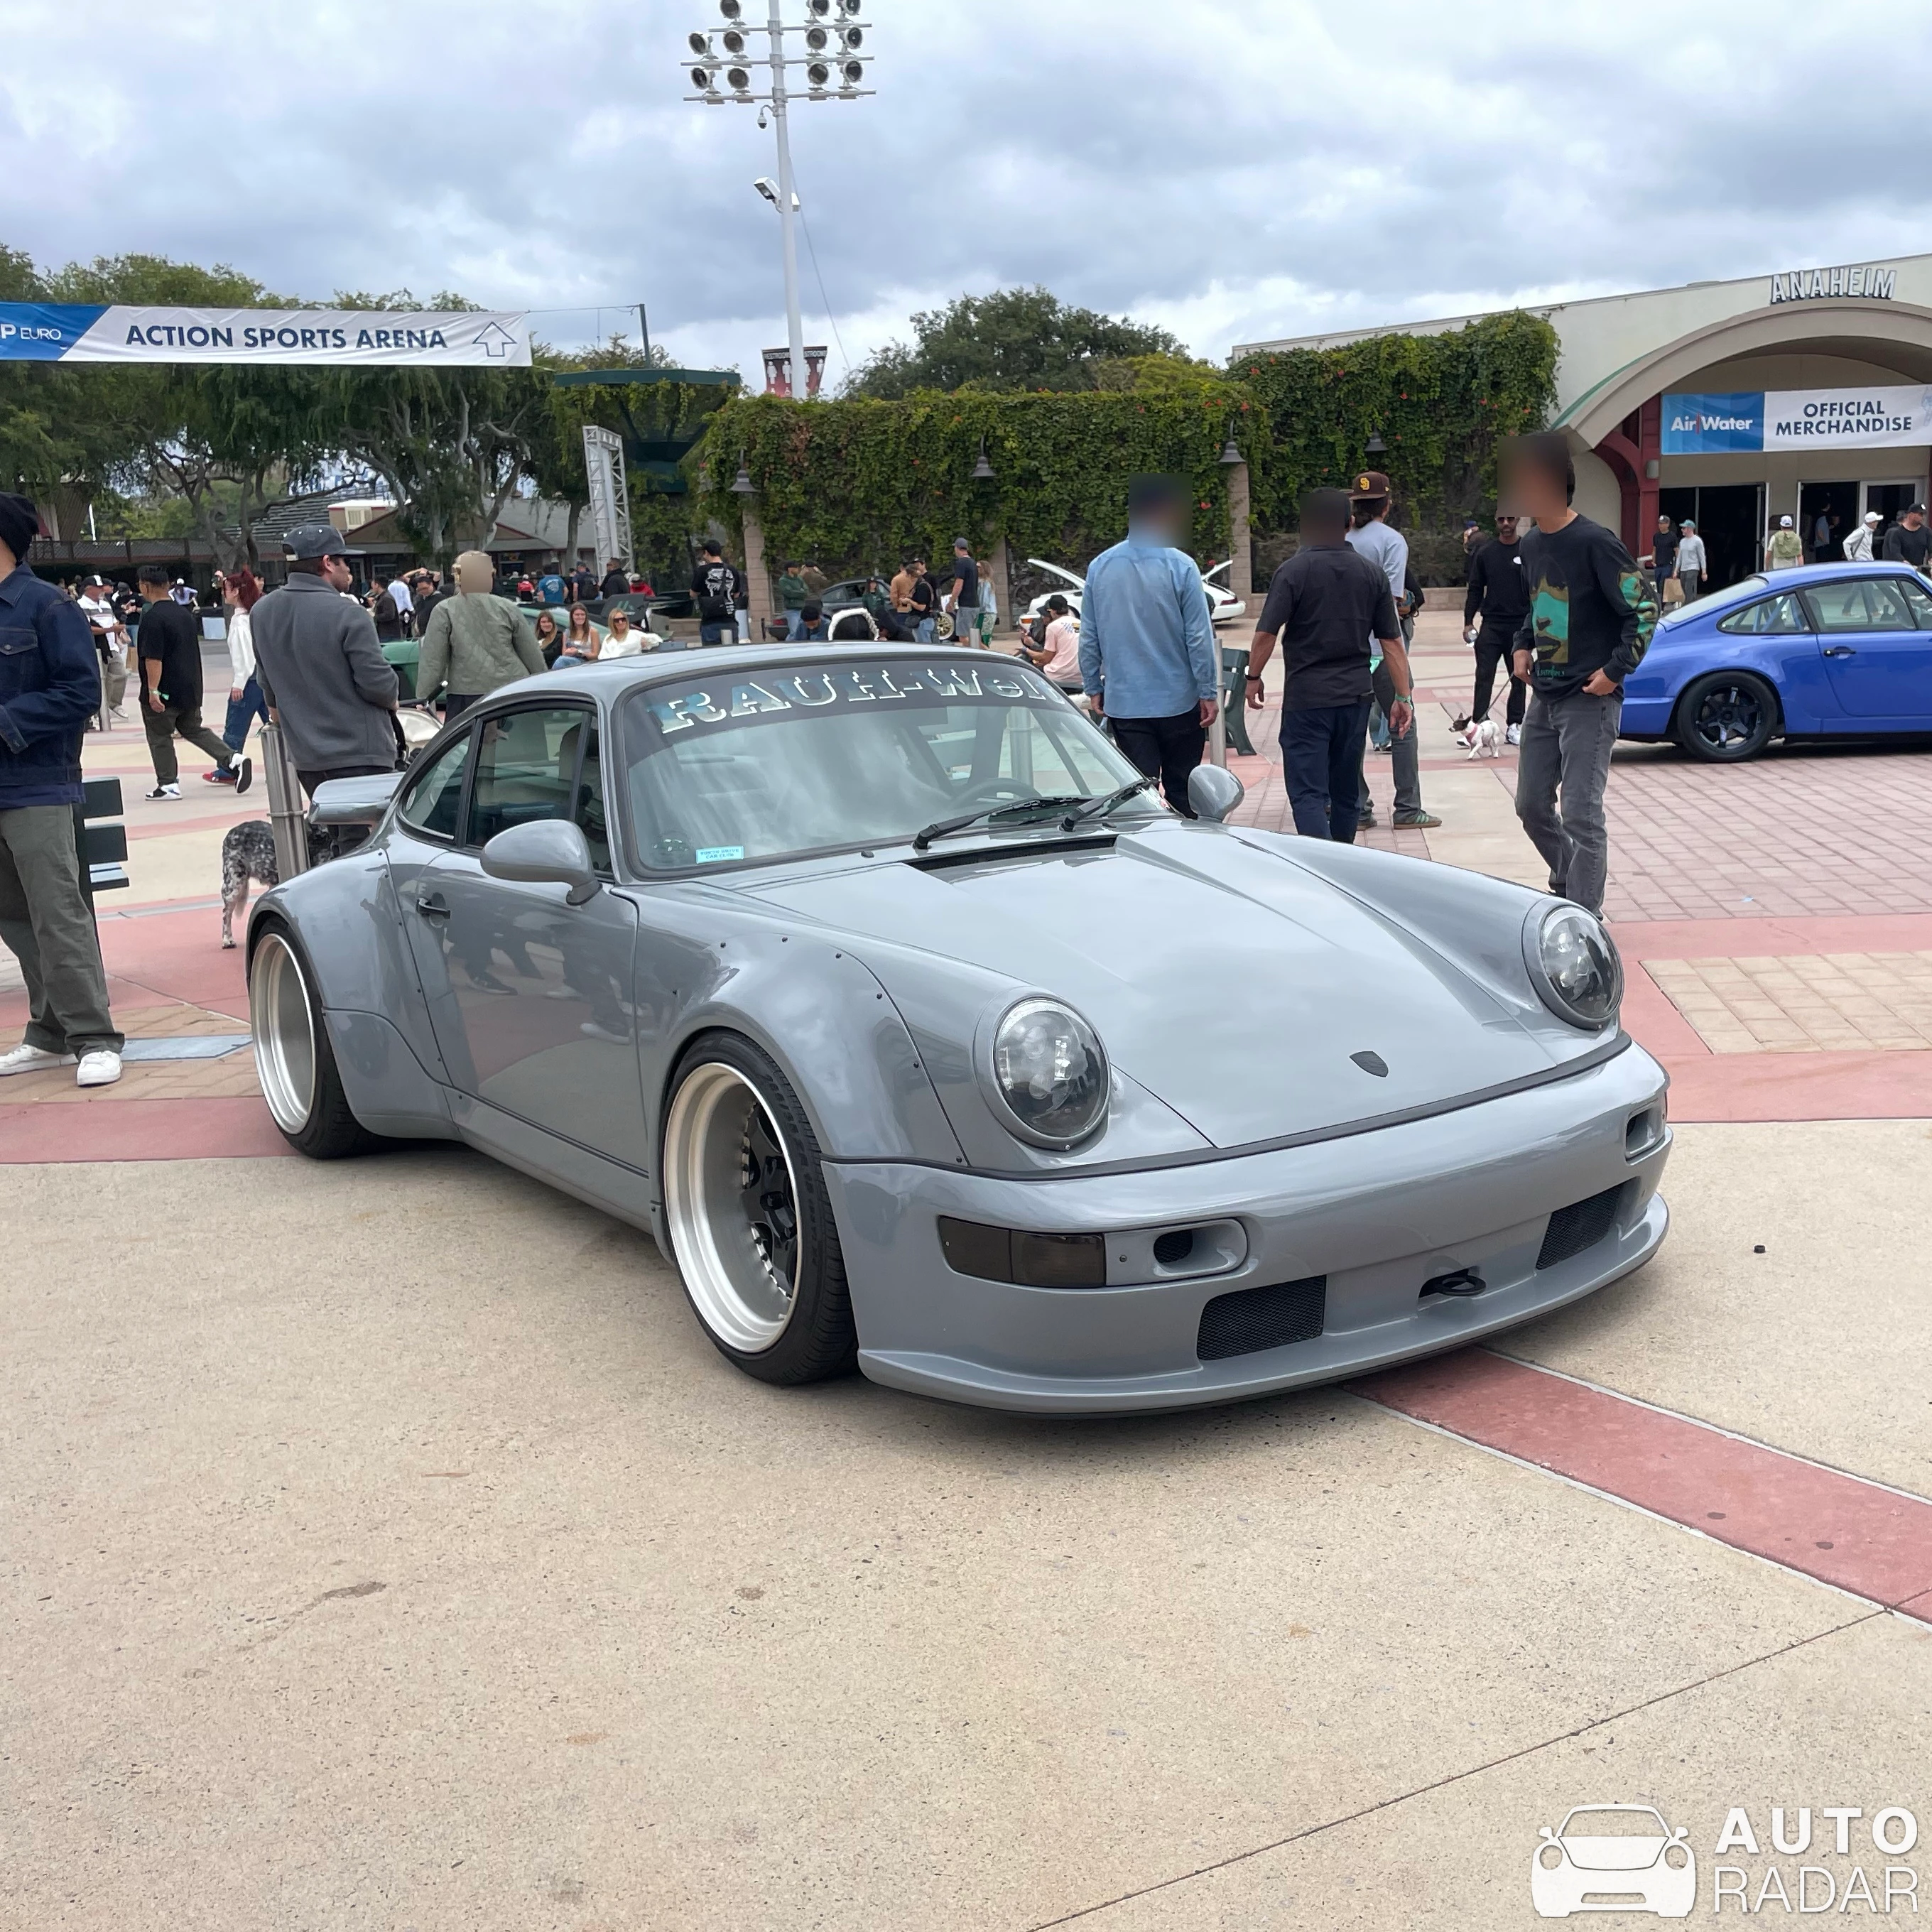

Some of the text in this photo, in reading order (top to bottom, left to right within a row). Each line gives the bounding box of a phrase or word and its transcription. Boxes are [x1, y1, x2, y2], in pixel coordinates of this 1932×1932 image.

[1771, 267, 1897, 304] ANAHEIM
[20, 327, 62, 340] EURO
[126, 325, 447, 348] ACTION SPORTS ARENA
[1803, 401, 1884, 418] OFFICIAL
[1776, 416, 1912, 435] MERCHANDISE
